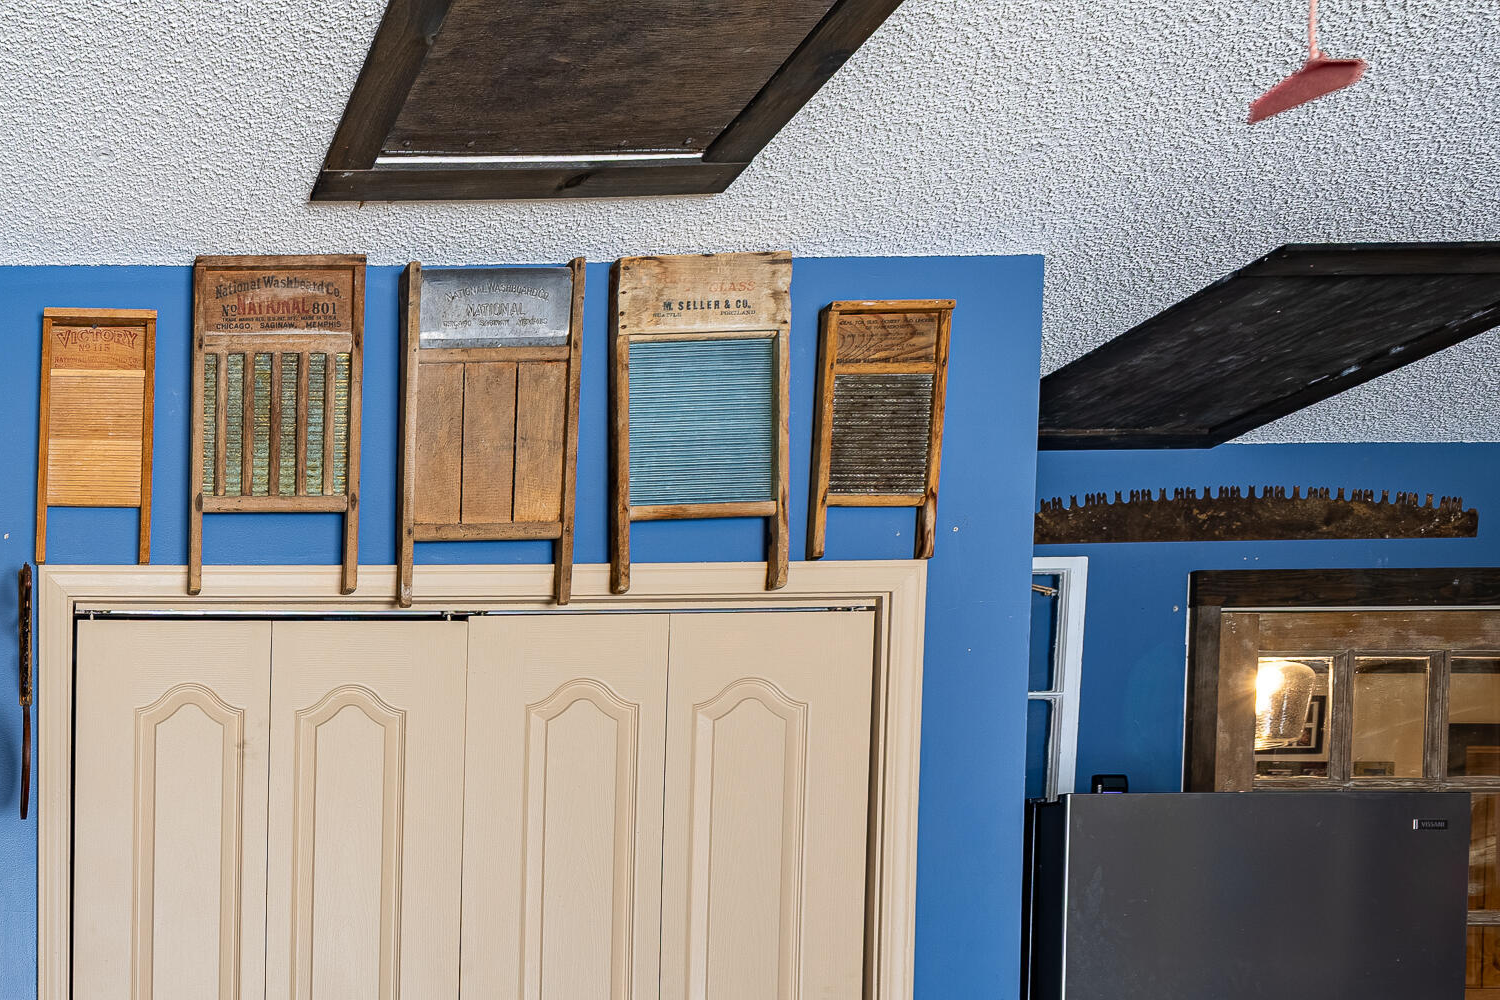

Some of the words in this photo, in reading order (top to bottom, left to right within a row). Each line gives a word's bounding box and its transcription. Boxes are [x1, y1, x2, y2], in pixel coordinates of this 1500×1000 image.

[215, 278, 261, 299] National
[262, 275, 325, 294] Washboard
[444, 284, 488, 302] NATIONAL
[709, 280, 756, 292] GLASS
[237, 295, 310, 316] NATIONAL
[311, 302, 337, 315] 801
[465, 302, 527, 317] NATIONAL
[678, 300, 720, 311] SELLER
[724, 300, 731, 310] &
[735, 299, 752, 310] CO.
[216, 322, 254, 331] CHICAGO,
[259, 321, 298, 330] SAGINAW,
[305, 320, 342, 329] MEMPHIS
[56, 330, 138, 350] VICTORY
